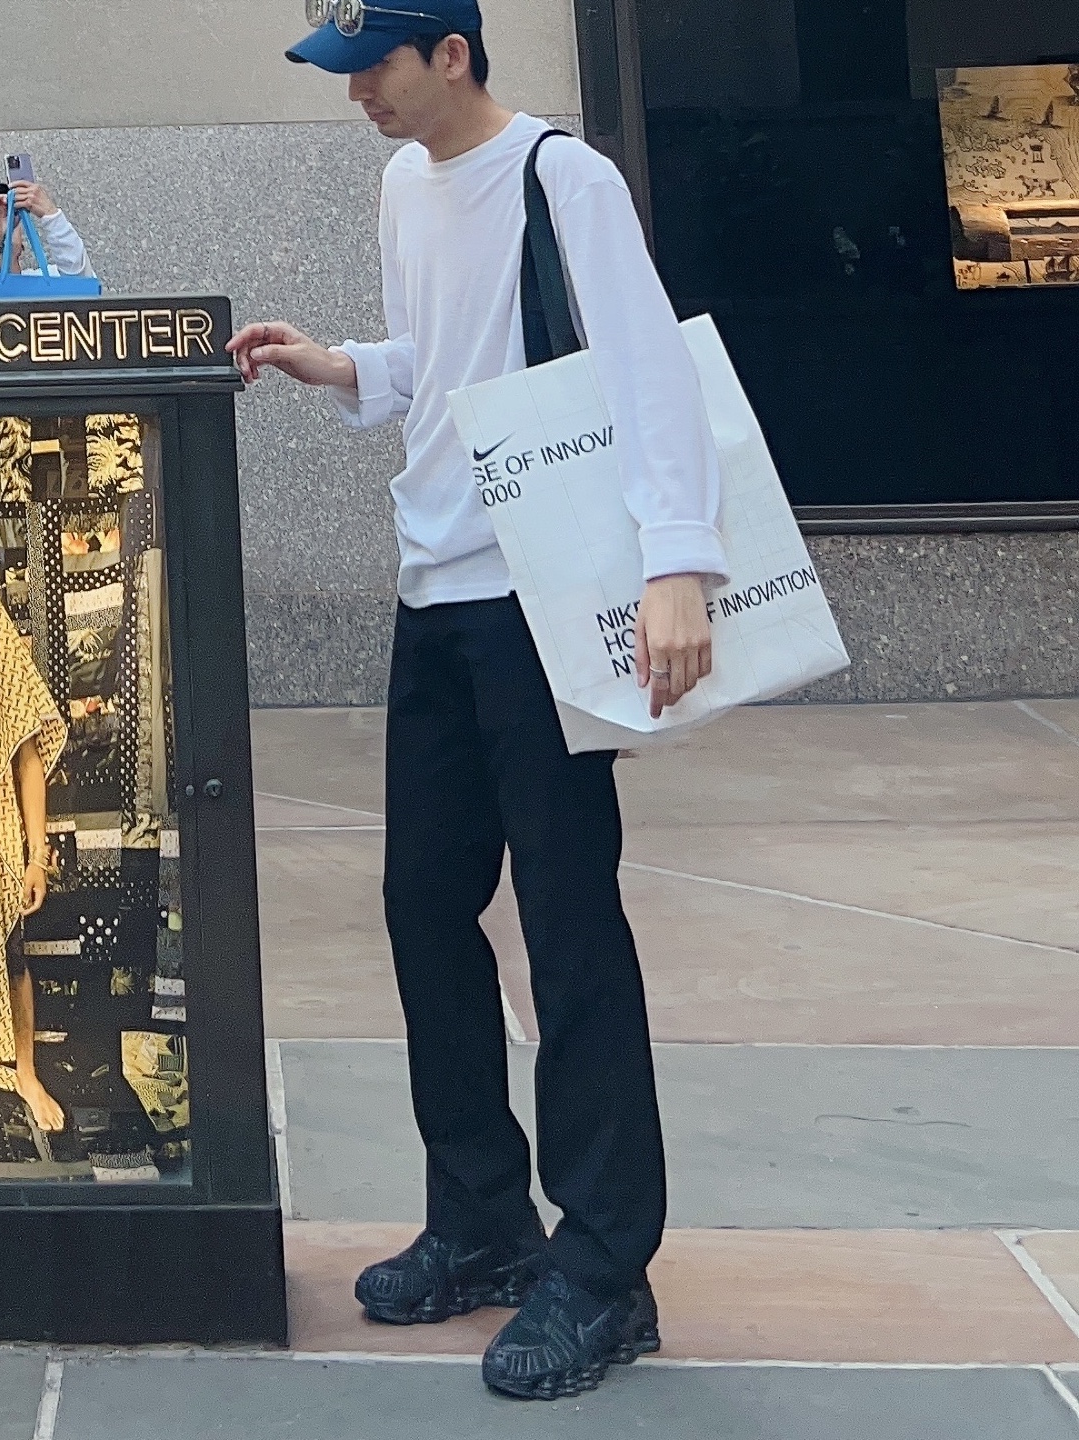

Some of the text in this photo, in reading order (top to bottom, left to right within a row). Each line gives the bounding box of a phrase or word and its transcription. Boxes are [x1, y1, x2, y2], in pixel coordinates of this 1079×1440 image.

[505, 450, 535, 475] OF
[706, 602, 717, 623] F
[718, 565, 817, 619] INNOVATION
